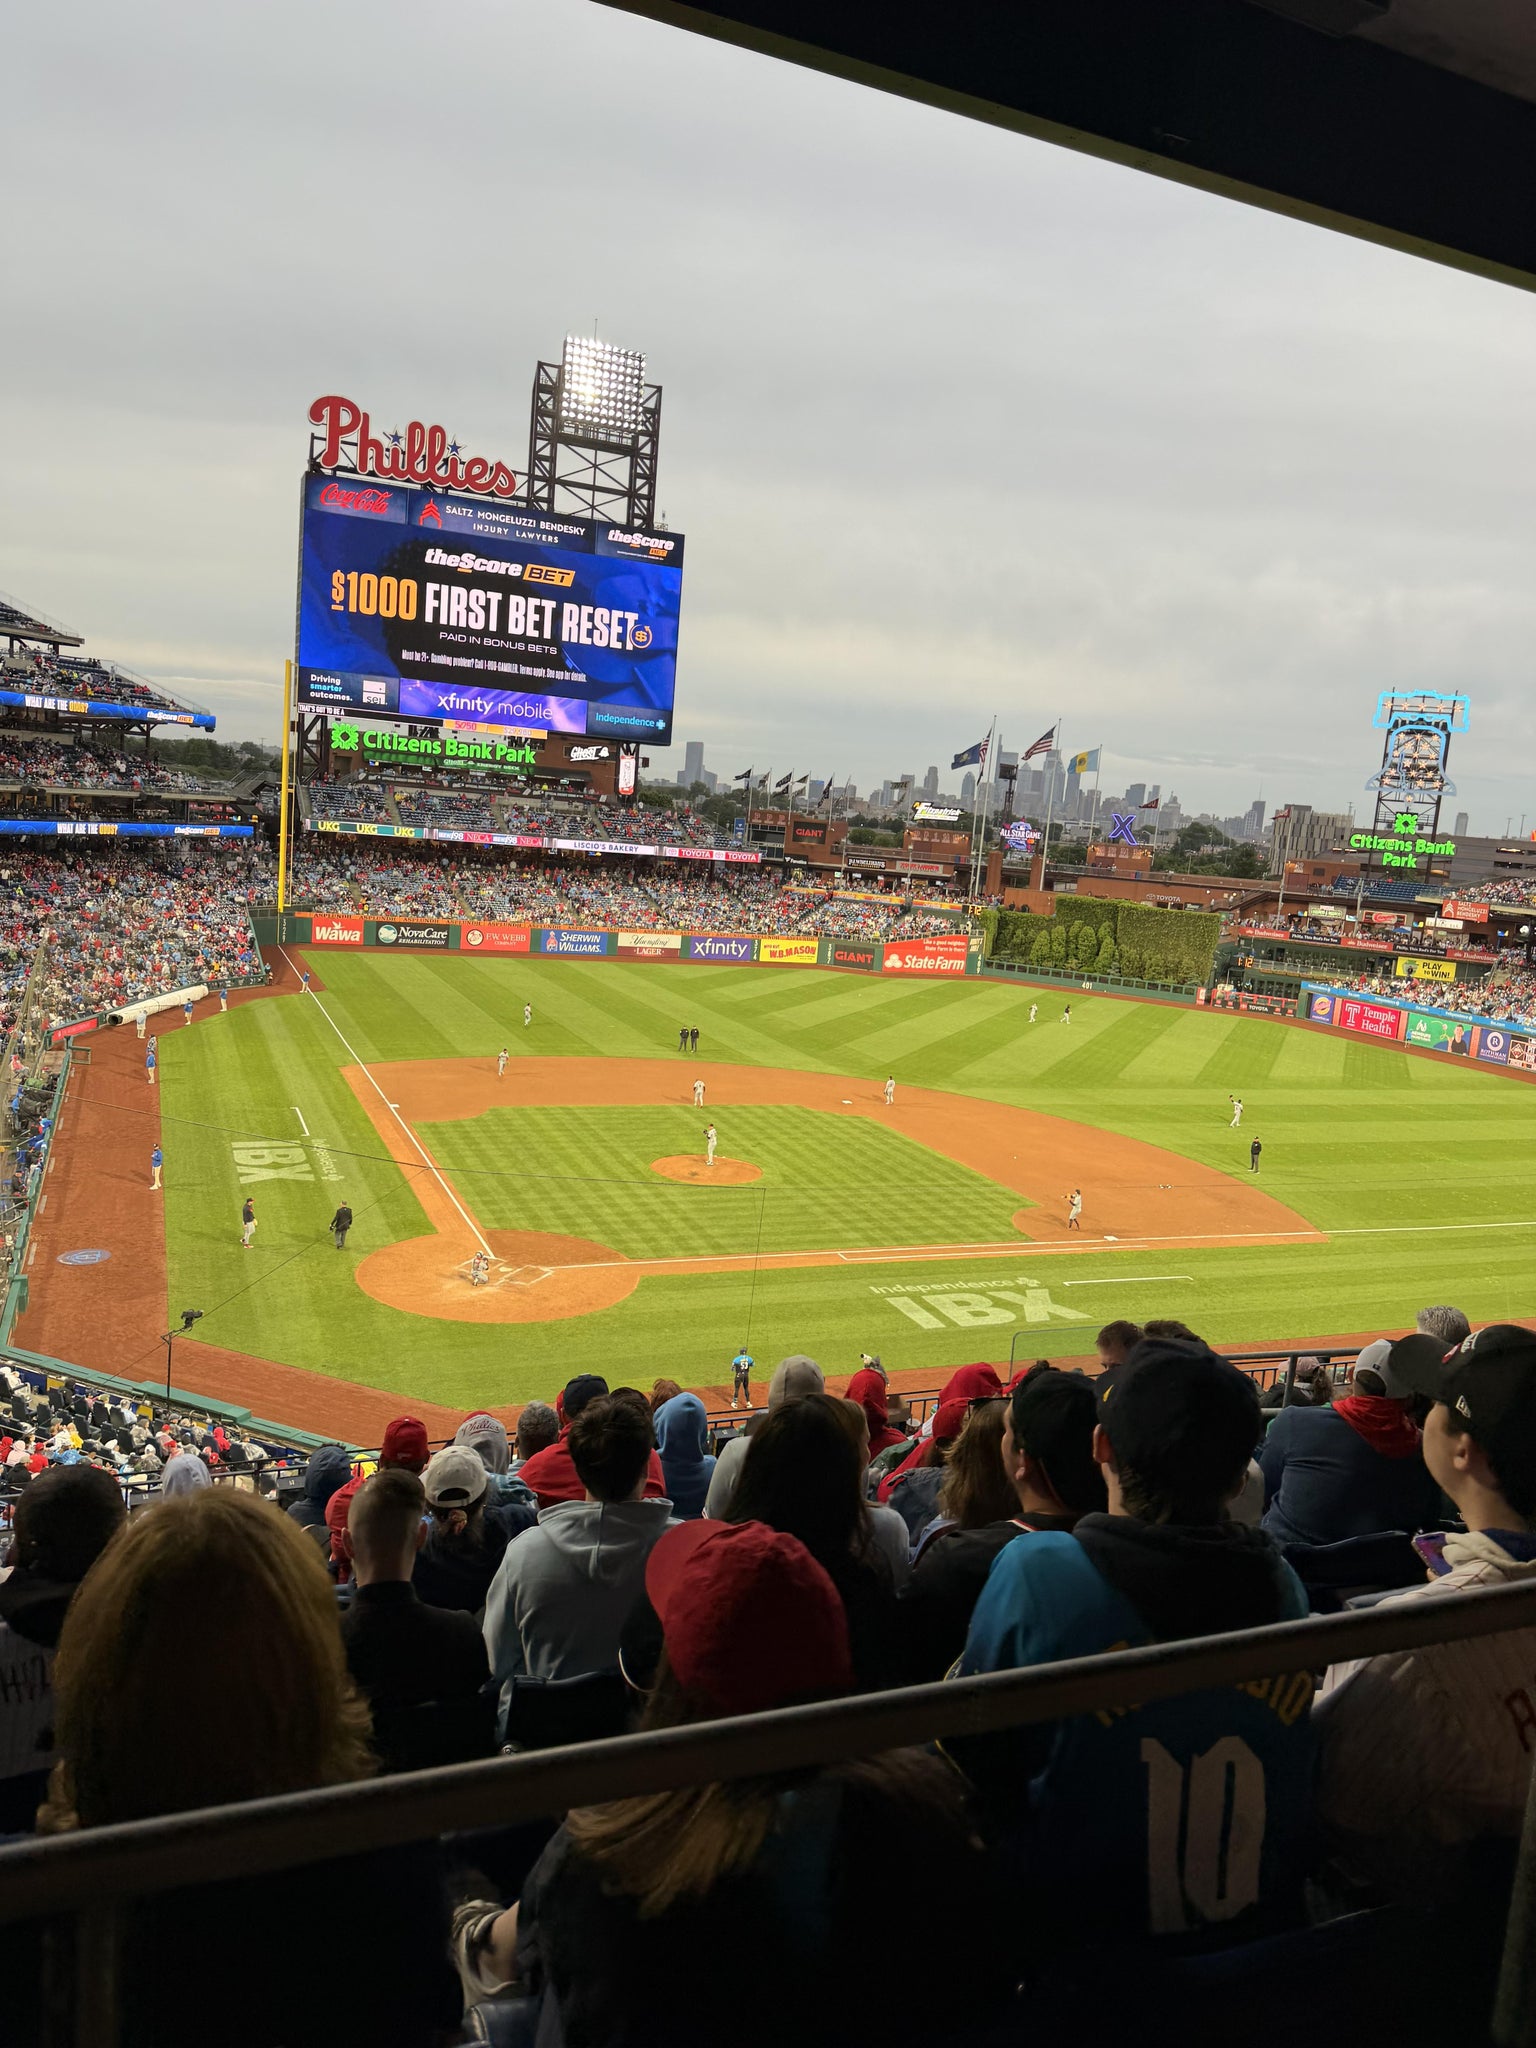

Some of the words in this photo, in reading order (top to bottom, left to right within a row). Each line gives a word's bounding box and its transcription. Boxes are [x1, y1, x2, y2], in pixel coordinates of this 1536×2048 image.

[309, 395, 516, 497] Phillies
[445, 505, 473, 518] SALTZ
[477, 511, 536, 529] MONGELUZZI
[540, 521, 586, 537] BENDESKY
[472, 522, 509, 536] INJURY
[515, 530, 559, 544] LAWYERS
[608, 529, 675, 551] theScore
[424, 548, 523, 578] theScore
[526, 566, 573, 584] BET
[331, 569, 418, 622] $1000
[425, 582, 501, 632] FIRST
[508, 594, 556, 639] BET
[562, 603, 639, 651] RESET
[439, 631, 466, 643] PAID
[468, 635, 481, 644] IN
[483, 636, 524, 651] BONUS
[527, 641, 558, 655] BETS
[310, 674, 341, 686] Driving
[310, 683, 343, 692] smarter
[25, 695, 43, 708] WHAT
[43, 697, 56, 710] ARE
[56, 698, 68, 710] THE
[309, 691, 353, 701] outcomes.
[437, 693, 494, 715] xfinity
[497, 702, 553, 720] mobile
[596, 712, 655, 728] Independence
[363, 730, 442, 755] Citizens
[445, 738, 492, 759] Bank
[495, 743, 536, 764] Park
[570, 745, 602, 762] GHOST
[57, 823, 73, 834] WHAT
[74, 823, 87, 834] ARE
[87, 824, 99, 835] THE
[318, 821, 340, 832] UKG
[356, 824, 378, 835] UKG
[394, 827, 415, 838] UKG
[796, 828, 823, 837] GIANT
[1108, 813, 1138, 846] X
[467, 833, 491, 843] NECA
[520, 837, 542, 847] NECA
[573, 841, 607, 851] LISCIO'S
[608, 844, 639, 853] BAKERY
[1350, 834, 1413, 852] Citizens
[1415, 838, 1456, 856] Bank
[681, 849, 711, 858] TOYOTA
[728, 852, 757, 861] TOYOTA
[1382, 852, 1417, 869] Park
[1156, 894, 1181, 902] TOYOTA
[315, 926, 362, 942] Wawa
[398, 926, 448, 939] NovaCare
[502, 933, 526, 942] WEBB
[559, 931, 601, 943] SHERWIN
[1254, 930, 1284, 938] Budweiser
[694, 938, 748, 958] xfinity
[1356, 940, 1388, 949] Budweiser
[636, 947, 662, 956] LAGER
[835, 950, 873, 964] GIANT
[1237, 957, 1254, 968] 1:12
[1422, 962, 1442, 970] PLAY
[1430, 971, 1450, 979] WIN!
[1082, 981, 1093, 990] 401
[1249, 1004, 1269, 1012] TOYOTA
[1345, 1003, 1361, 1026] T
[1363, 1006, 1396, 1023] Temple
[1361, 1019, 1392, 1035] Health
[1492, 1037, 1499, 1046] R
[231, 1139, 316, 1185] IBX
[869, 1278, 1016, 1295] Independence
[884, 1288, 1093, 1329] IBX
[740, 1361, 748, 1370] 53
[1140, 1735, 1266, 1935] 10
